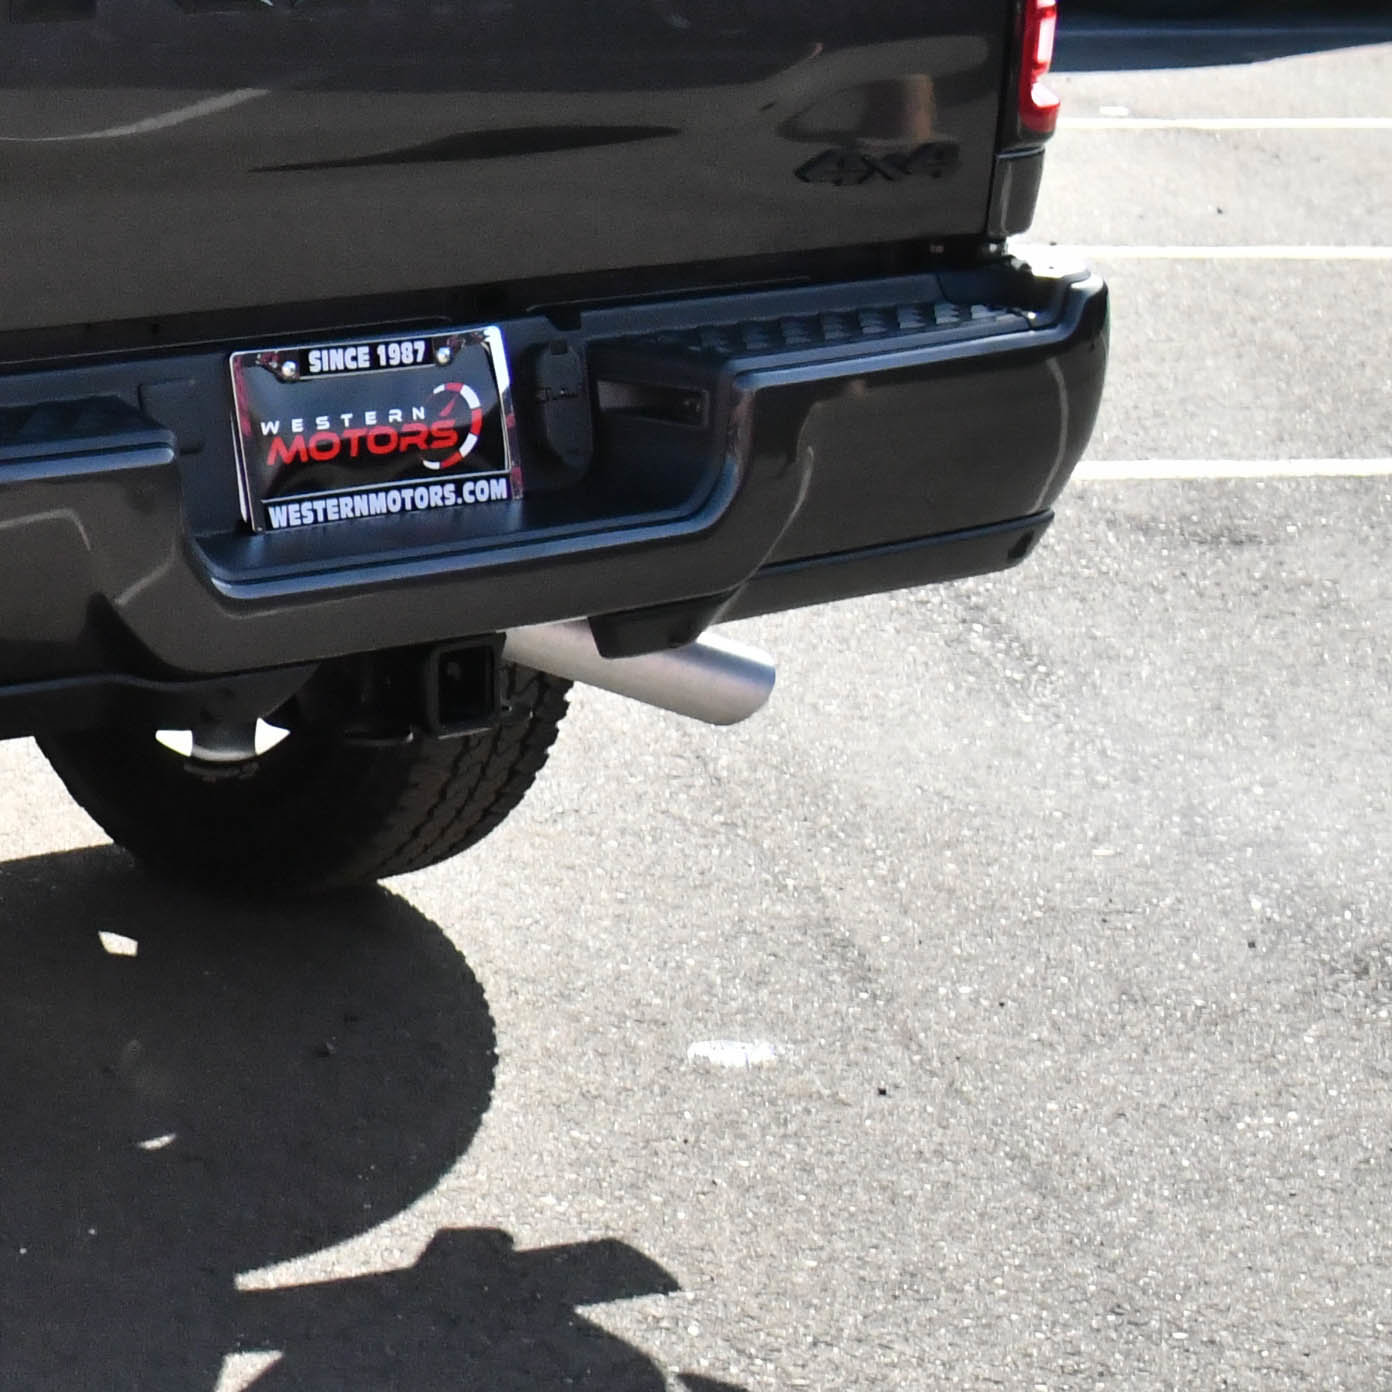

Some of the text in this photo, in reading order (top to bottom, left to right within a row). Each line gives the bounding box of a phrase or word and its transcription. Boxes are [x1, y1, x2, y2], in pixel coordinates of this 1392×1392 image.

[307, 339, 427, 374] SINCE 1987
[260, 405, 426, 437] WESTERN
[266, 419, 459, 467] MOTORS
[267, 476, 509, 530] WESTERNMOTORS.COM
